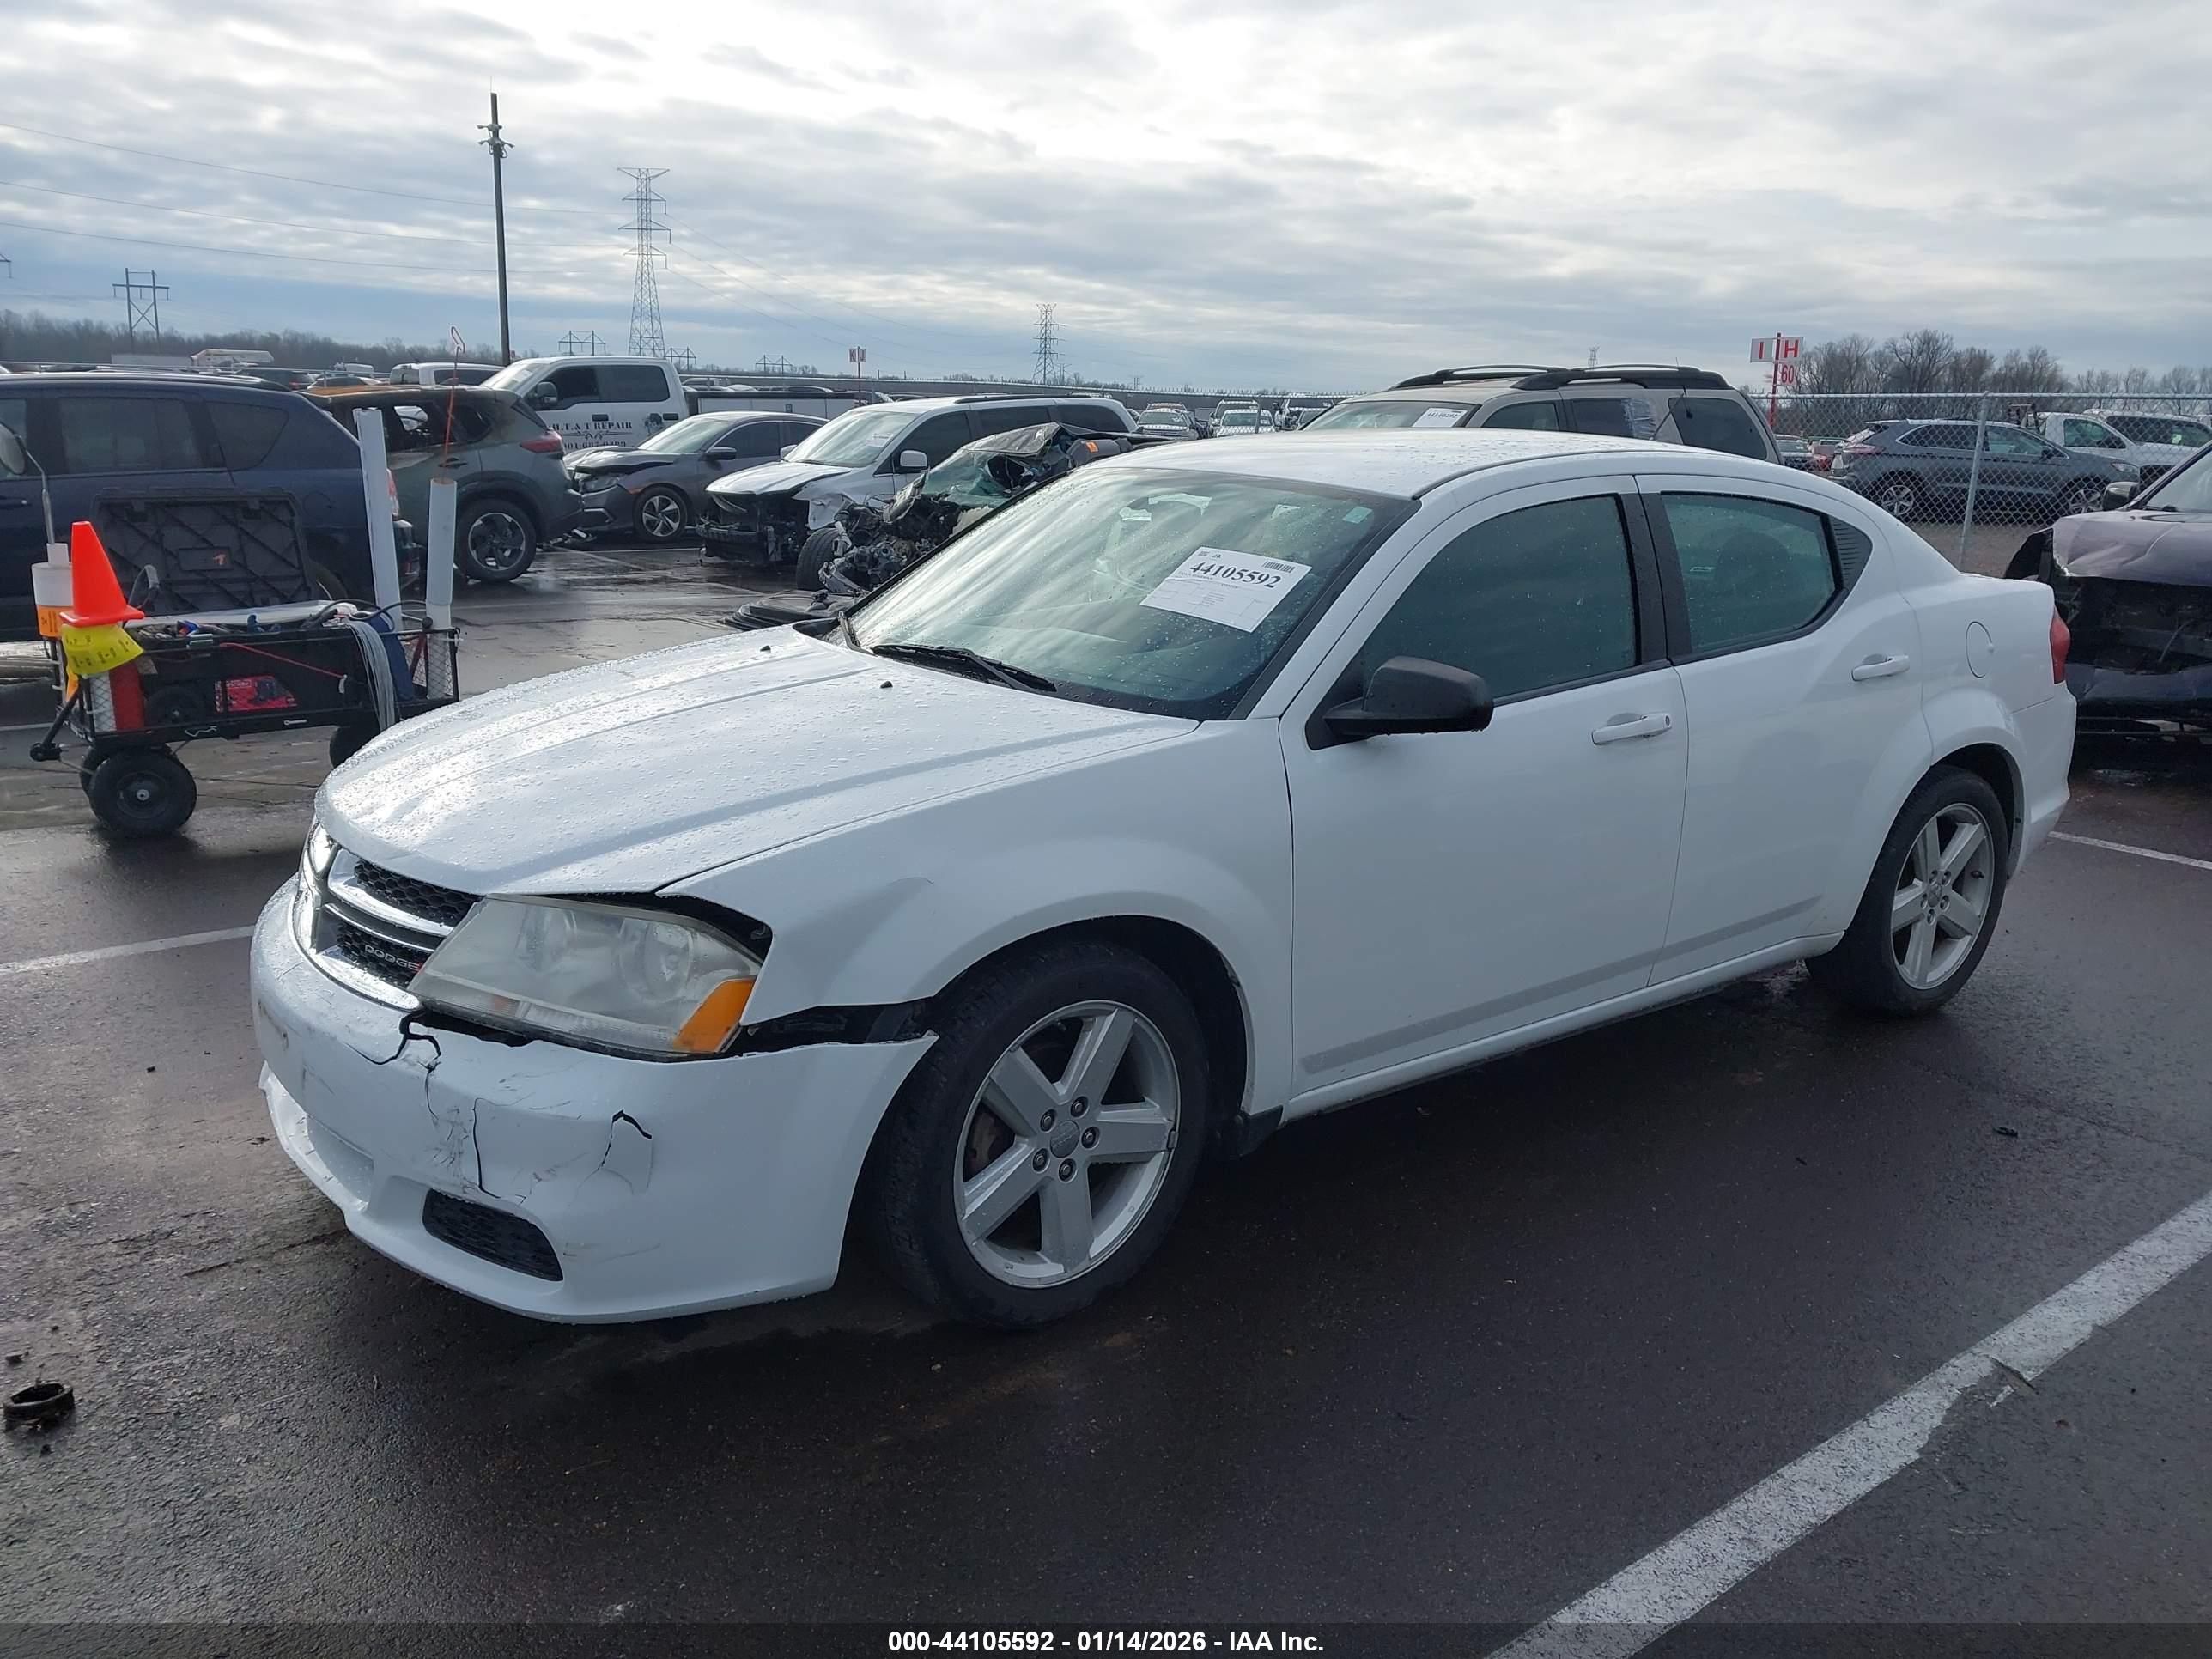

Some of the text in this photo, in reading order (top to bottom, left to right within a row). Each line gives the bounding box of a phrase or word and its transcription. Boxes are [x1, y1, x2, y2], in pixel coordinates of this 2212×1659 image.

[1784, 340, 1799, 357] H
[1781, 365, 1794, 383] 60
[1189, 562, 1281, 588] 44105592
[365, 945, 420, 971] DODGE
